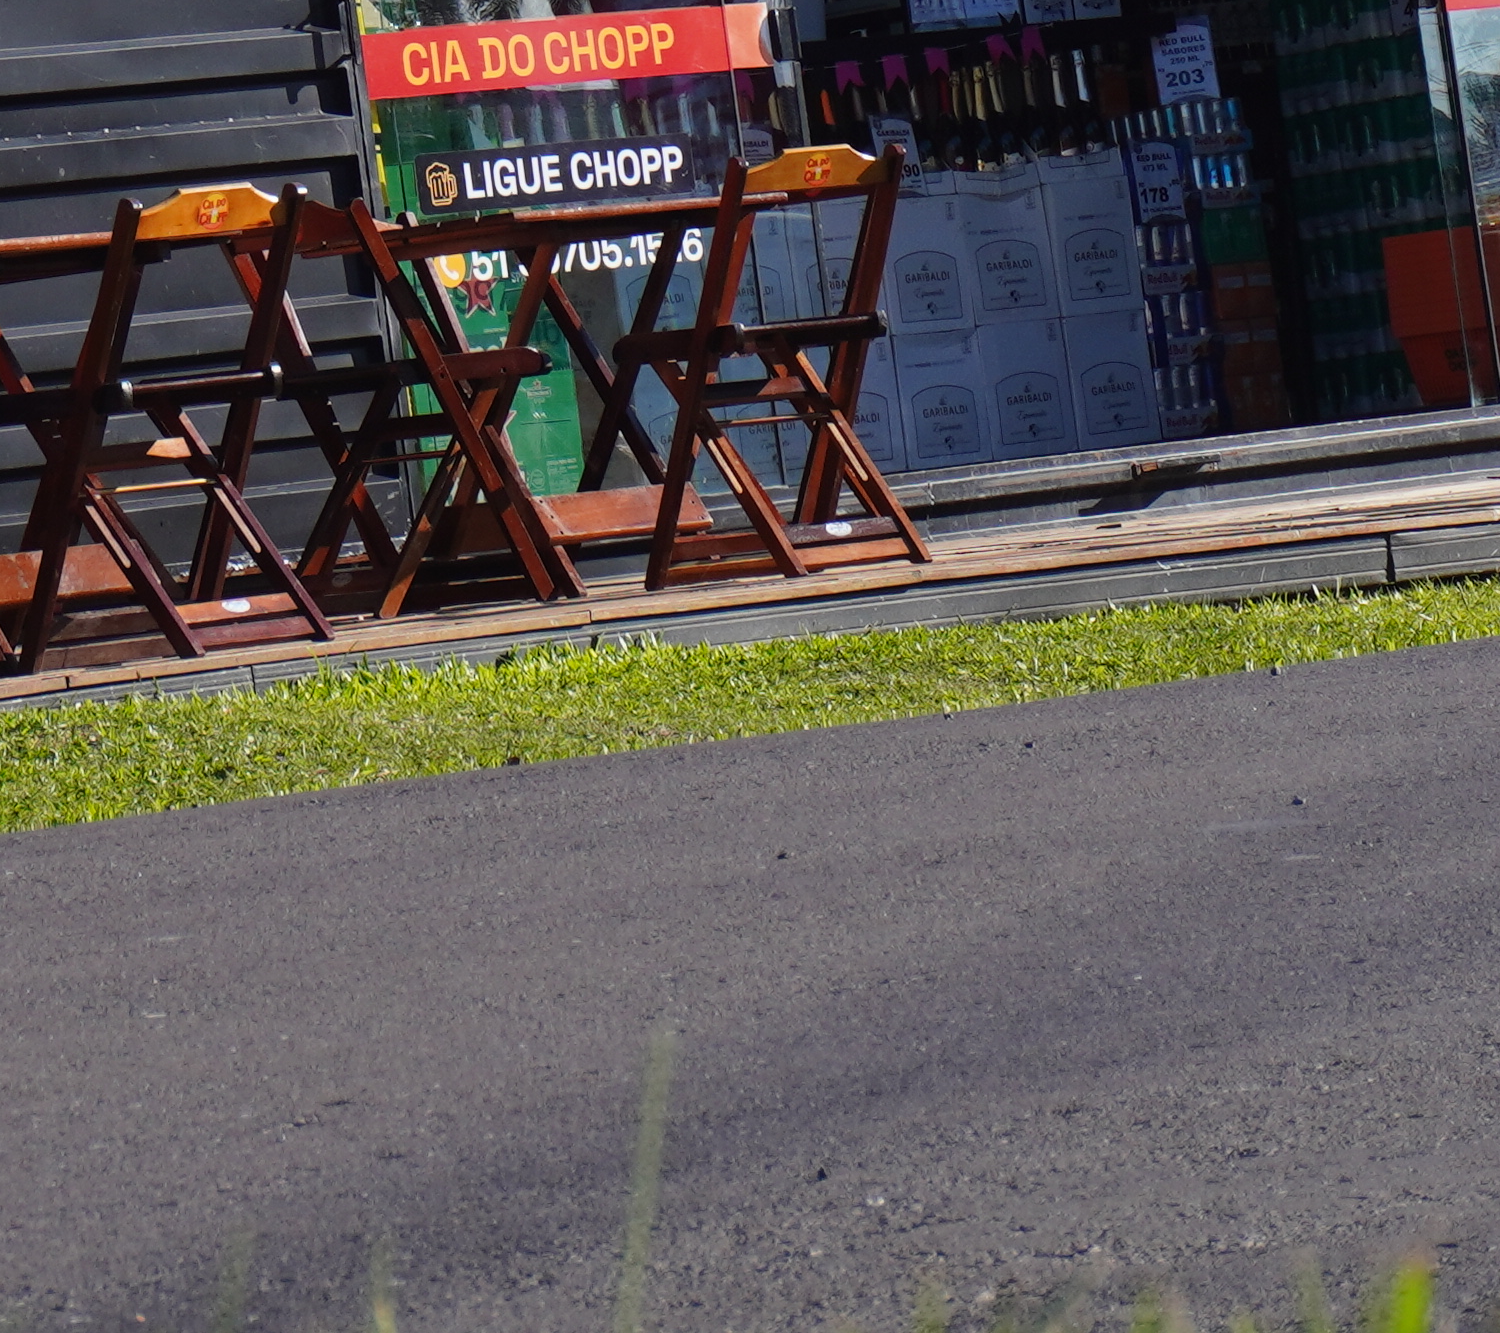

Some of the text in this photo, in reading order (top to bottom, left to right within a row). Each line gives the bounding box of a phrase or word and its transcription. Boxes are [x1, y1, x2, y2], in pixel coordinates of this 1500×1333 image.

[402, 22, 676, 87] CIA DO CHOPP
[1166, 68, 1205, 88] 203
[463, 142, 684, 201] LIGUE CHOPP
[1141, 188, 1169, 204] 178
[1074, 250, 1118, 262] GARIBALDI
[986, 259, 1033, 271] GARIBALDI
[905, 271, 950, 283] GARIBALDI
[1007, 393, 1052, 406] GARIBALDI
[923, 405, 969, 418] GARIBALDI
